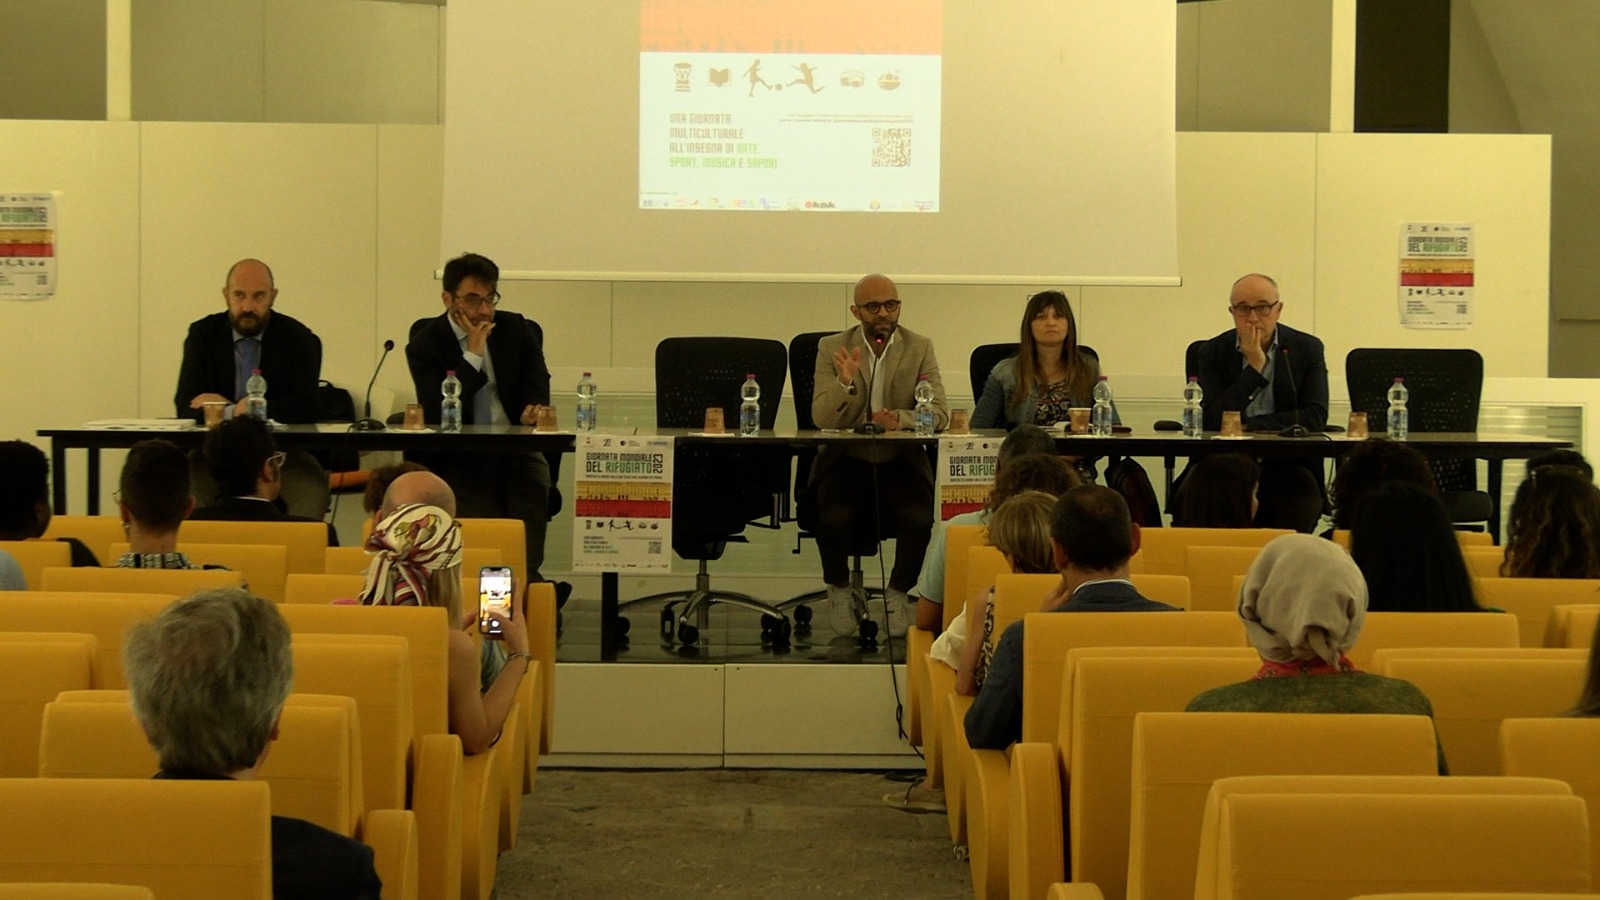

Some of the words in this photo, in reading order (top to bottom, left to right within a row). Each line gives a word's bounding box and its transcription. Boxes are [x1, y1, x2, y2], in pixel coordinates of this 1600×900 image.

[669, 113, 686, 125] UNA
[689, 113, 732, 125] GIORNATA
[669, 127, 744, 139] MULTICULTURALE
[669, 142, 723, 154] ALL'INSEGNA
[725, 143, 734, 154] DI
[702, 157, 736, 168] MUSICA
[738, 157, 744, 168] E
[586, 452, 618, 461] GIORNATA
[620, 453, 653, 462] MONDIALE
[949, 455, 981, 465] GIORNATA
[586, 461, 602, 473] DEL
[605, 461, 652, 474] RIFUGIATO
[652, 453, 663, 474] 2023
[950, 465, 966, 477] DEL
[969, 464, 995, 476] RIFUG
